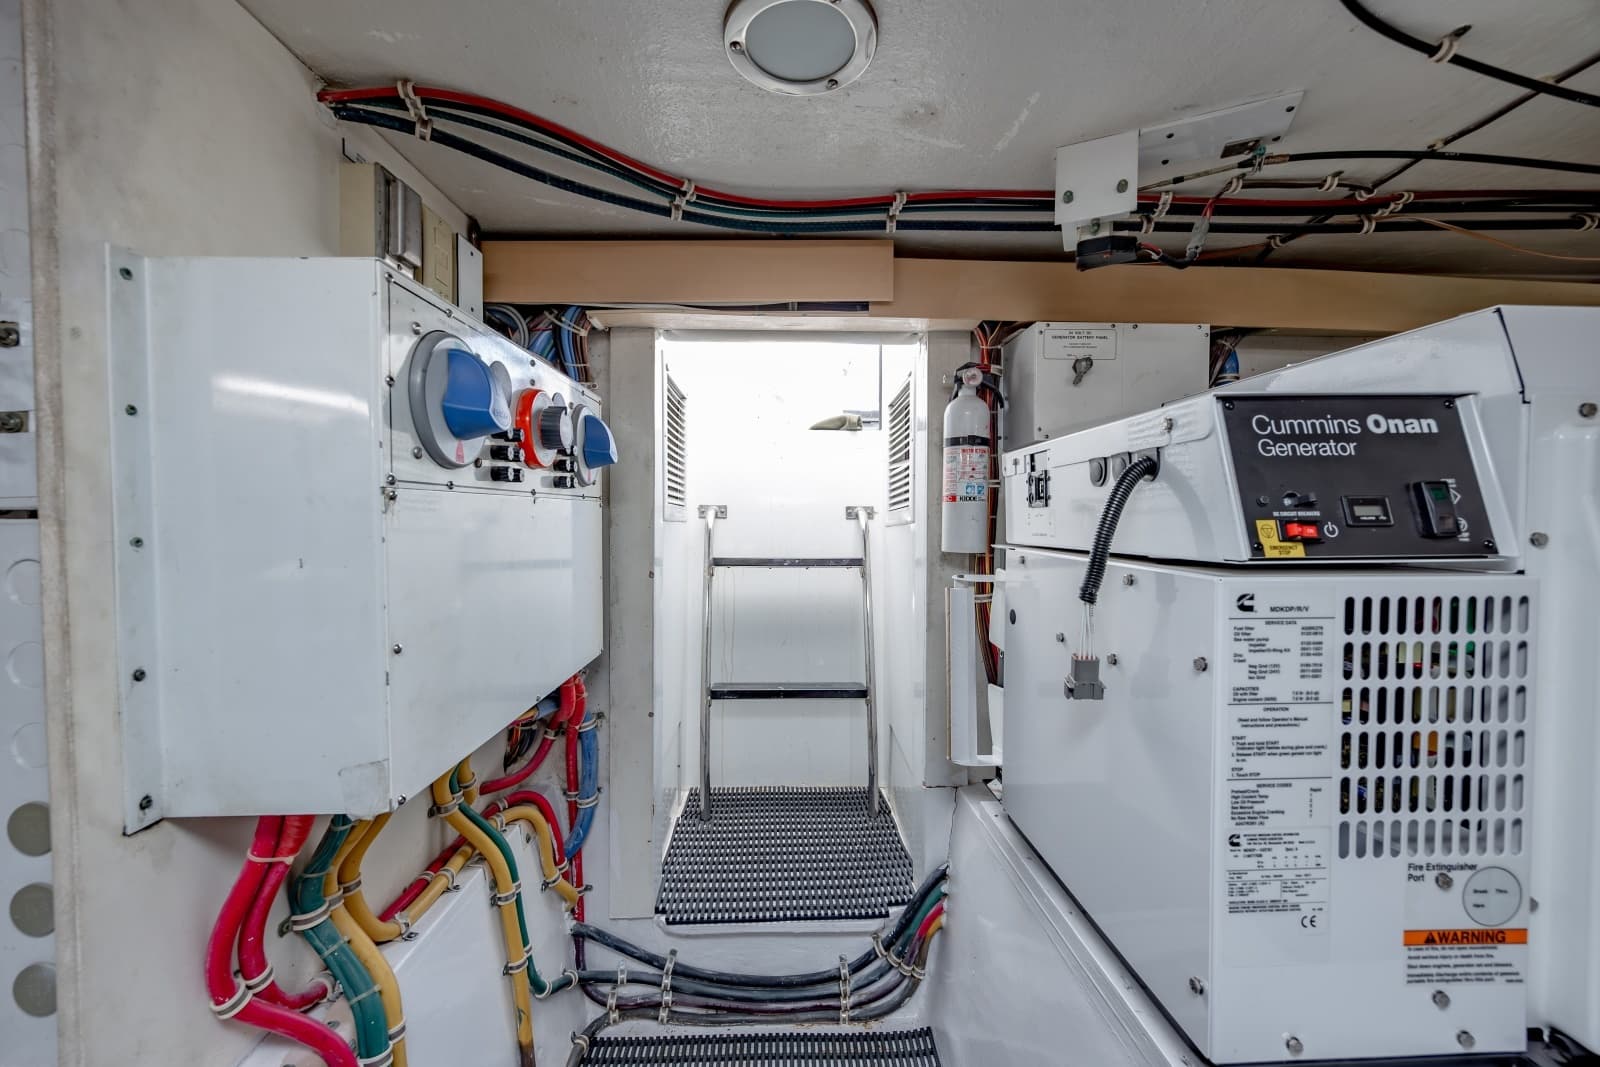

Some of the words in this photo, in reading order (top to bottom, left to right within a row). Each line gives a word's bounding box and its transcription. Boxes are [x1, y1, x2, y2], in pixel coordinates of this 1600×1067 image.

[1252, 414, 1361, 435] Cummins
[1366, 413, 1439, 434] Onan
[1257, 438, 1357, 456] Generator
[1408, 863, 1424, 871] Fire
[1426, 862, 1477, 872] Extinguisher
[1437, 930, 1506, 944] WARNING
